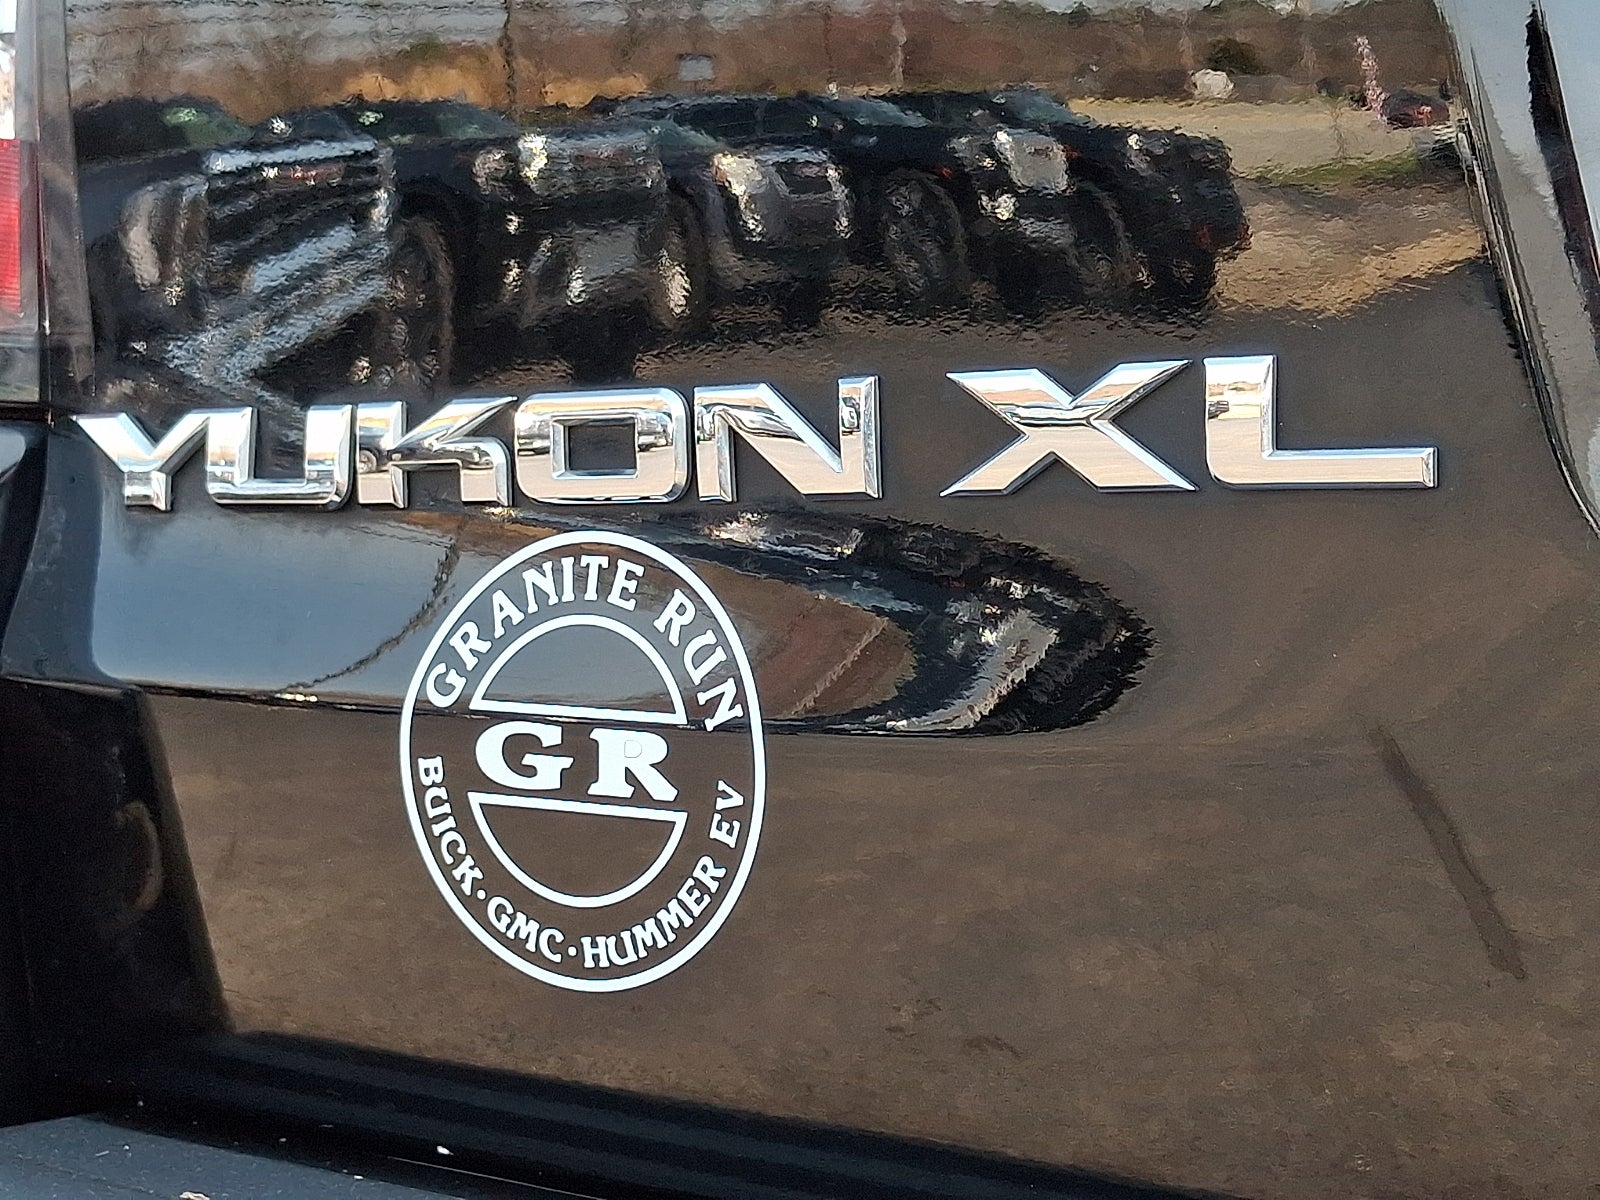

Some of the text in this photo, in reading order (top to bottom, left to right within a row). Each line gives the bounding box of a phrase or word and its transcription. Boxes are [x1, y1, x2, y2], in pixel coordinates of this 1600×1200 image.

[72, 354, 1437, 511] YUKON XL
[426, 554, 744, 732] GRANITE RUN
[475, 720, 678, 802] GR
[417, 755, 744, 968] BUICK GMC HUMMER EV
